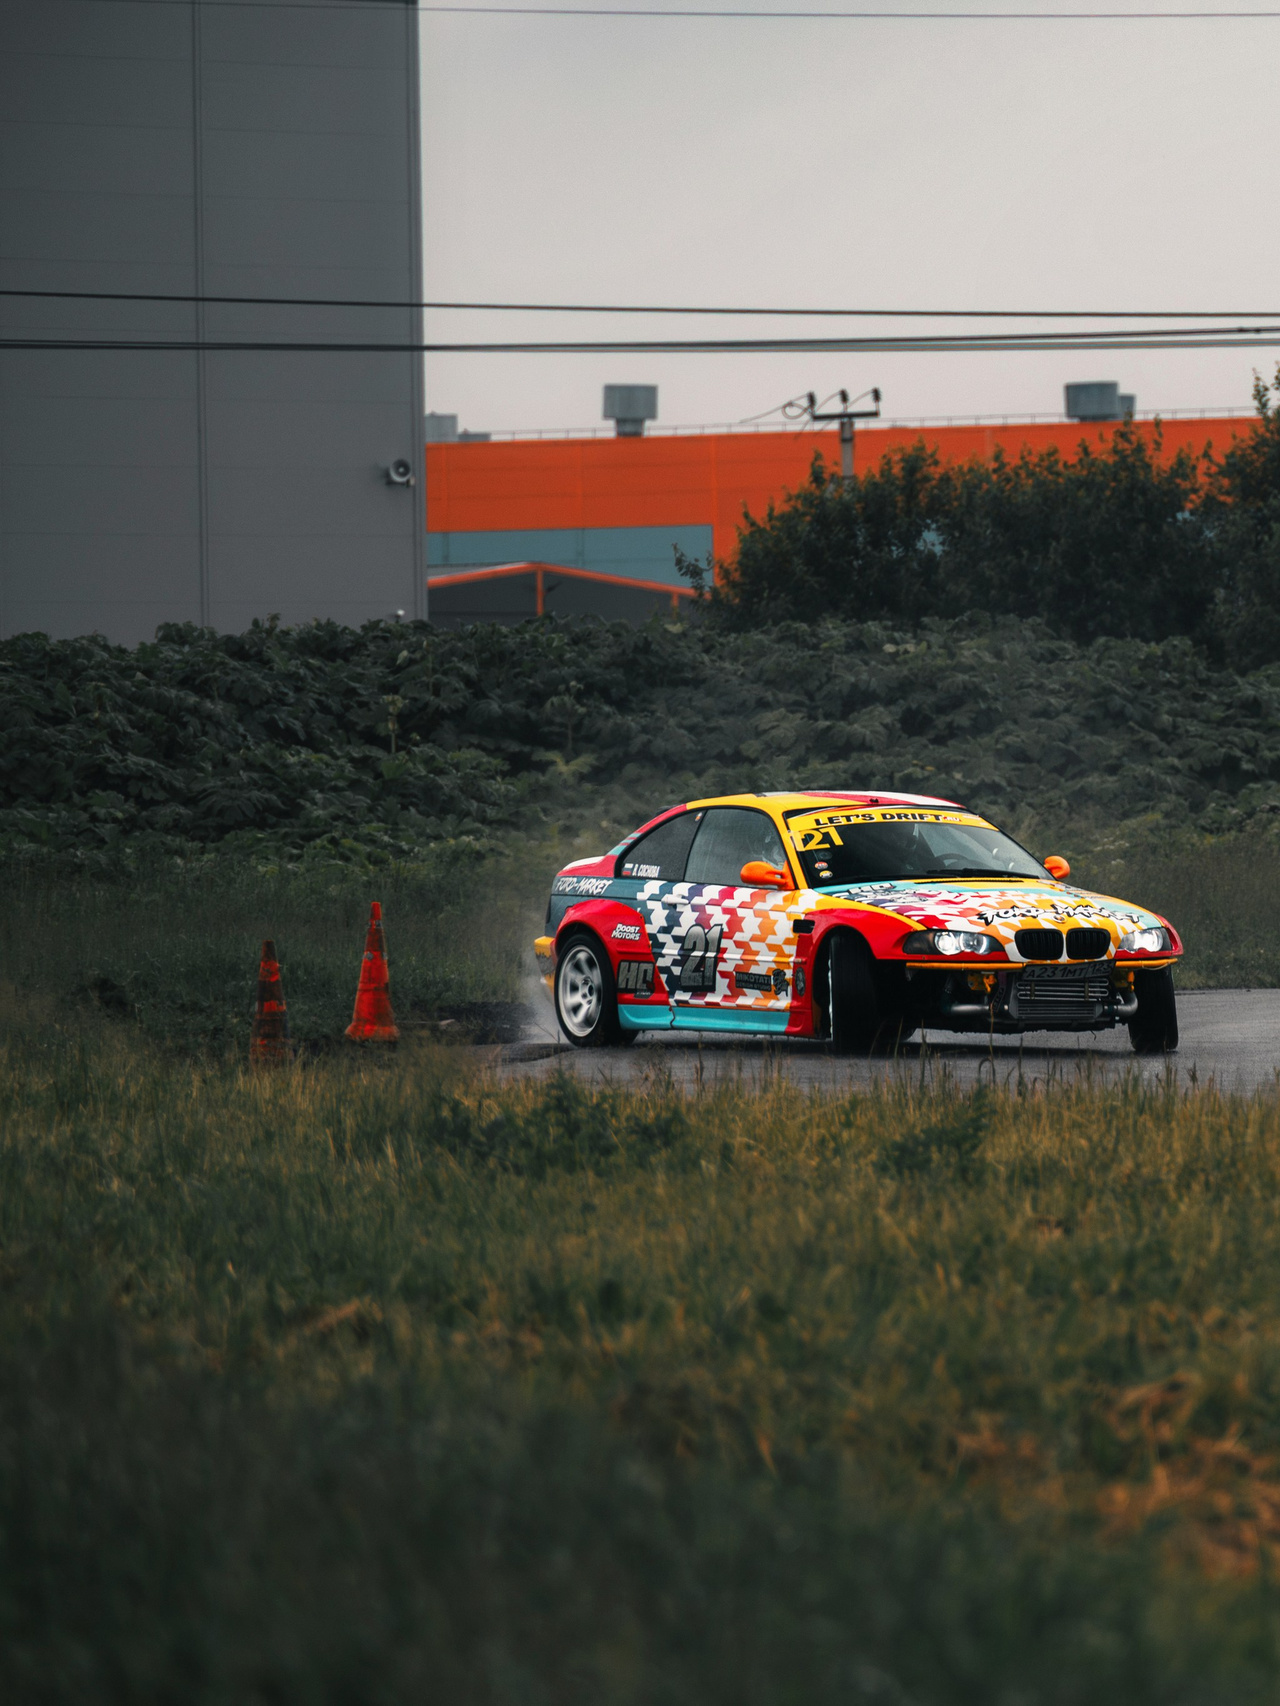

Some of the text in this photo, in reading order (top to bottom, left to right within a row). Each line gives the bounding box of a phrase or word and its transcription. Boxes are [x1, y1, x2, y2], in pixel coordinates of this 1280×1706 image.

[814, 814, 876, 827] LET'S
[799, 826, 844, 851] 21
[615, 923, 640, 933] BOOST
[611, 930, 641, 941] MOTORS
[680, 924, 722, 989] 21
